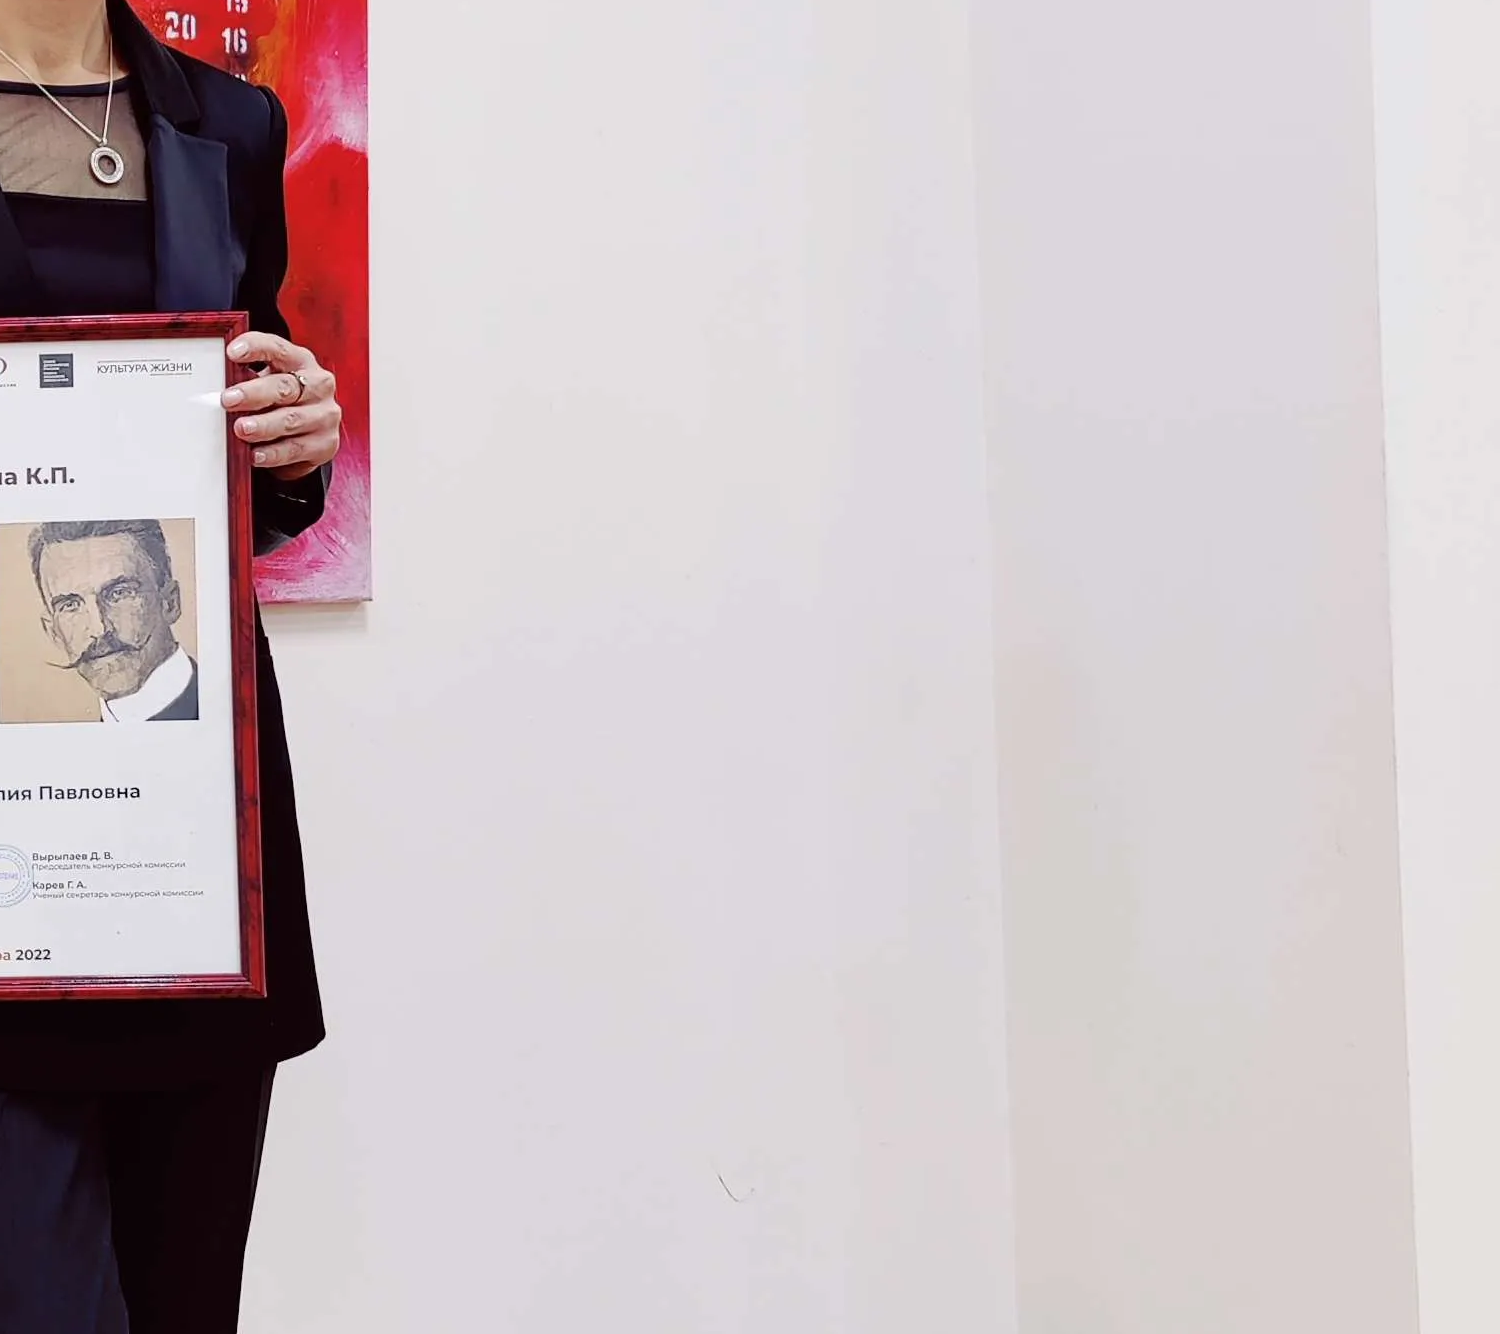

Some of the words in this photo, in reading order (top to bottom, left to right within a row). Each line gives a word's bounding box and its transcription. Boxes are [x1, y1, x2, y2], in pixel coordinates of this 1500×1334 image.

[165, 11, 197, 41] 20
[221, 27, 248, 55] 16
[97, 364, 148, 374] КУЛЬТУРА
[150, 362, 192, 372] ЖИЗНИ
[26, 467, 75, 485] К.П.
[39, 785, 141, 800] Павловна
[32, 852, 88, 863] Вырыпаев
[90, 851, 101, 861] Д.
[104, 851, 114, 860] В.
[144, 861, 186, 869] комиссии
[32, 880, 65, 891] Карев
[67, 880, 75, 889] Г.
[76, 880, 88, 889] А.
[65, 891, 109, 899] секретарь
[15, 948, 51, 961] 2022
